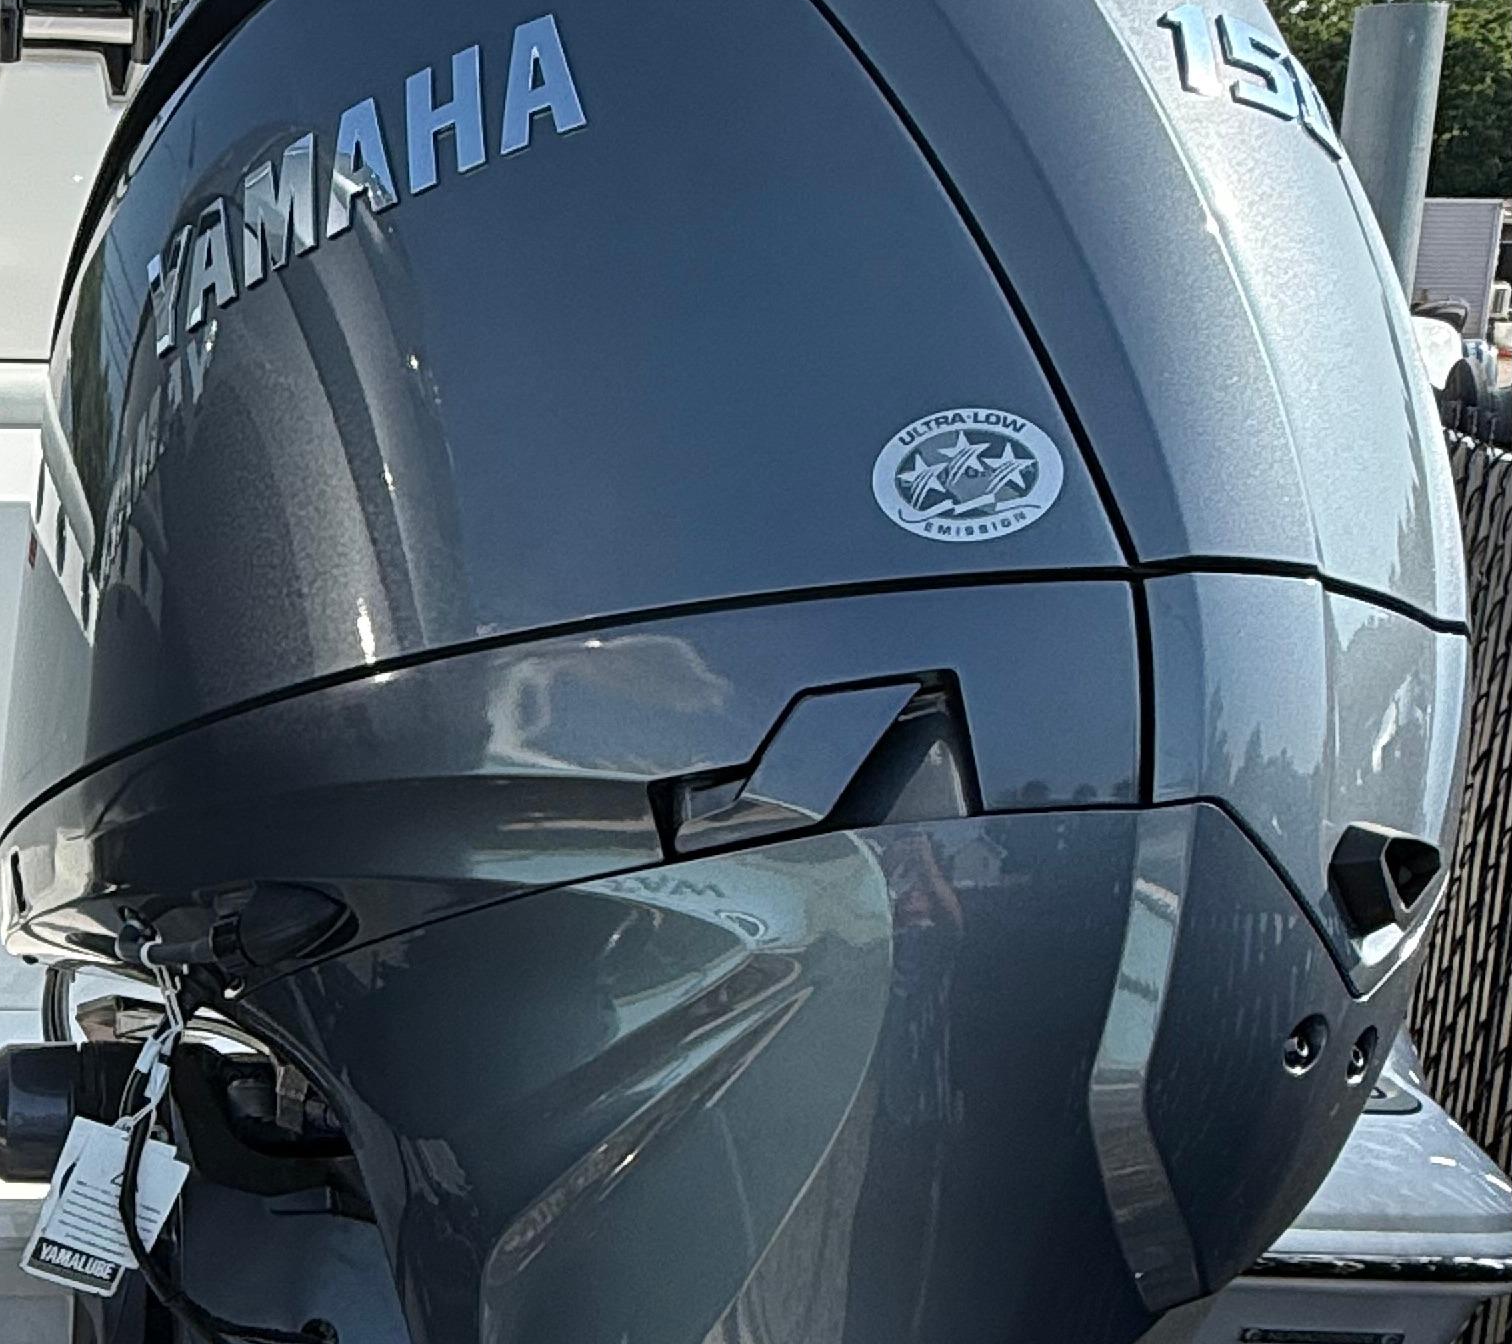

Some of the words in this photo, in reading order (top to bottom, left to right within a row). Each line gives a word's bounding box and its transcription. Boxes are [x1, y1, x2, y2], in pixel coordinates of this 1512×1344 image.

[147, 13, 588, 358] YAMAHA
[923, 510, 1028, 537] EMISSION
[39, 1242, 117, 1280] YAMALUBE
